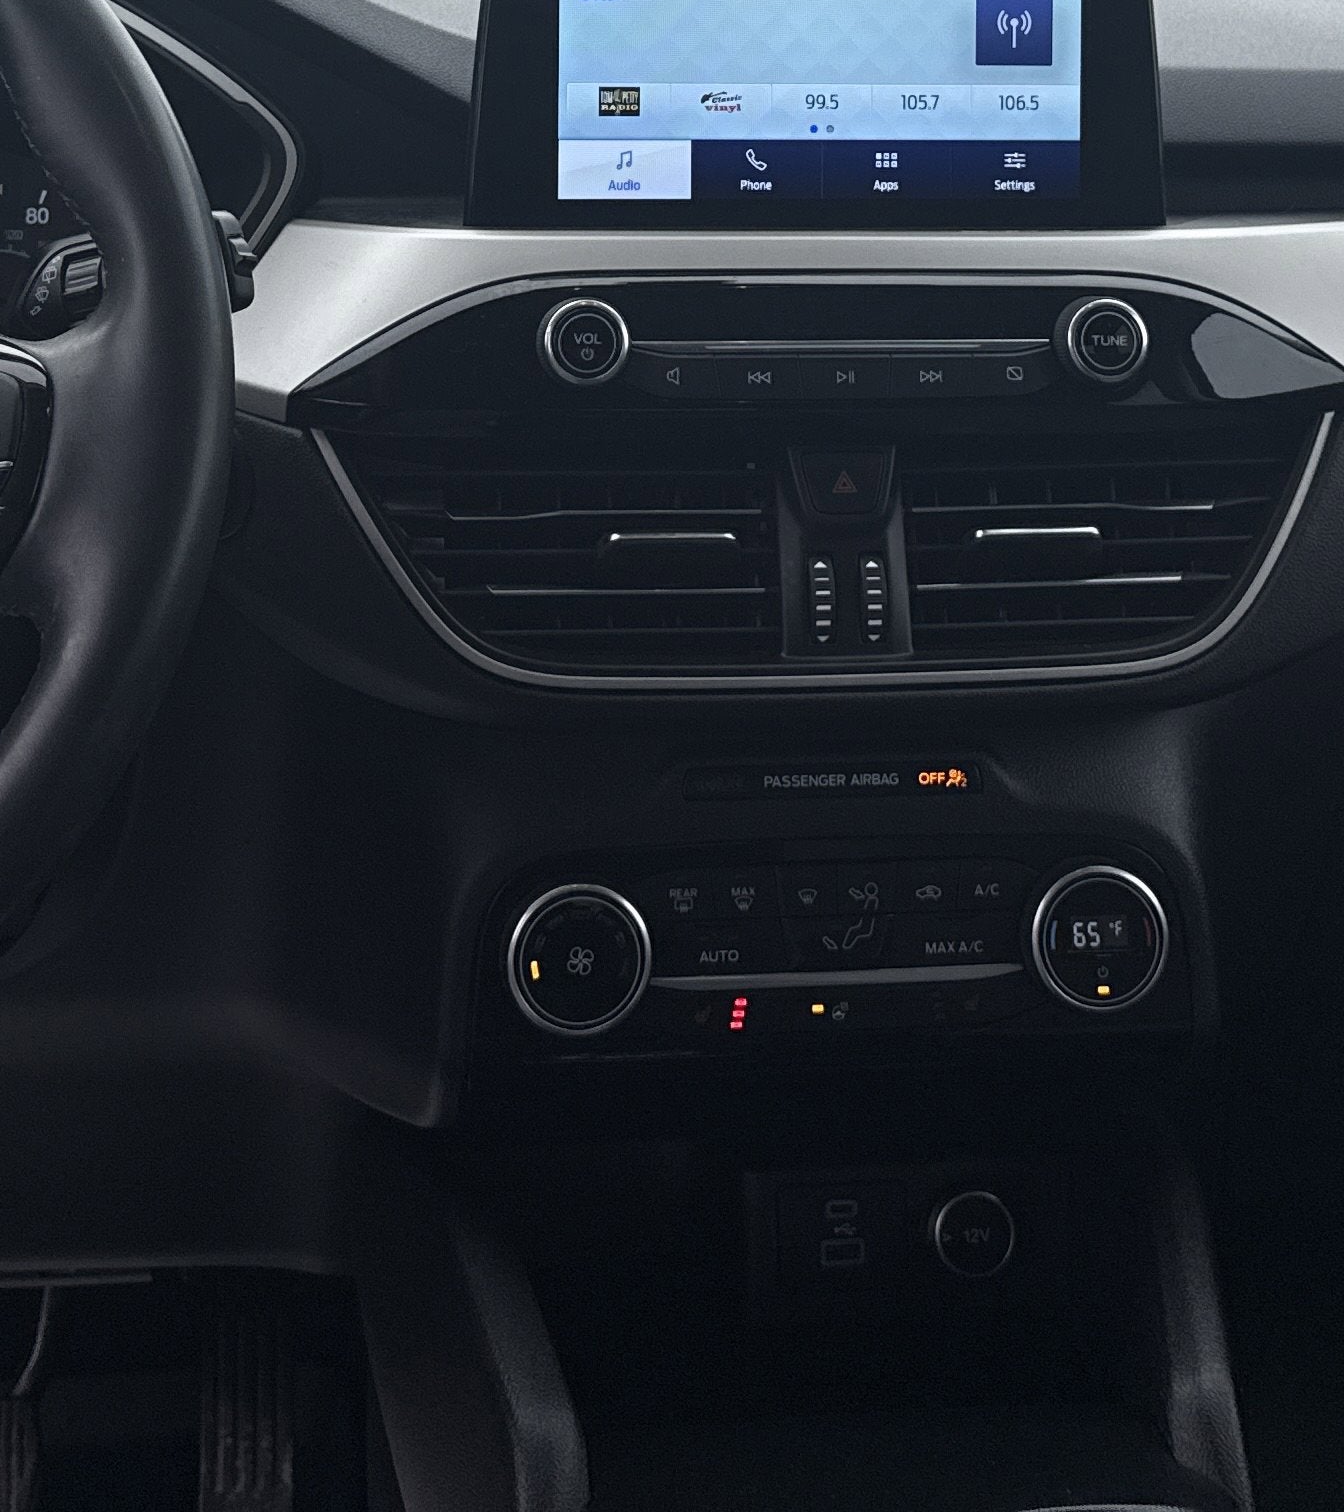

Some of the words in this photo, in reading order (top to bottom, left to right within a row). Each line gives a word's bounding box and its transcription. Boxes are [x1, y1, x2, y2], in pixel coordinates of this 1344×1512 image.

[805, 94, 839, 110] 99.5
[900, 94, 940, 110] 105.7
[998, 95, 1040, 111] 106.5
[608, 179, 641, 191] Audio
[740, 179, 773, 191] Phone
[873, 179, 899, 192] Apps
[994, 179, 1036, 193] Settings
[25, 207, 50, 225] 80
[573, 333, 603, 345] VOL
[1091, 335, 1128, 346] TUNE
[763, 774, 846, 787] PASSENGER
[850, 772, 899, 785] AIRBAG
[918, 771, 945, 784] OFF
[669, 888, 698, 898] REAR
[731, 887, 755, 896] MAX
[974, 884, 1000, 896] A/C
[1073, 921, 1100, 947] 65
[925, 942, 954, 954] MAX
[958, 940, 984, 953] A/C
[699, 950, 739, 962] AUTO
